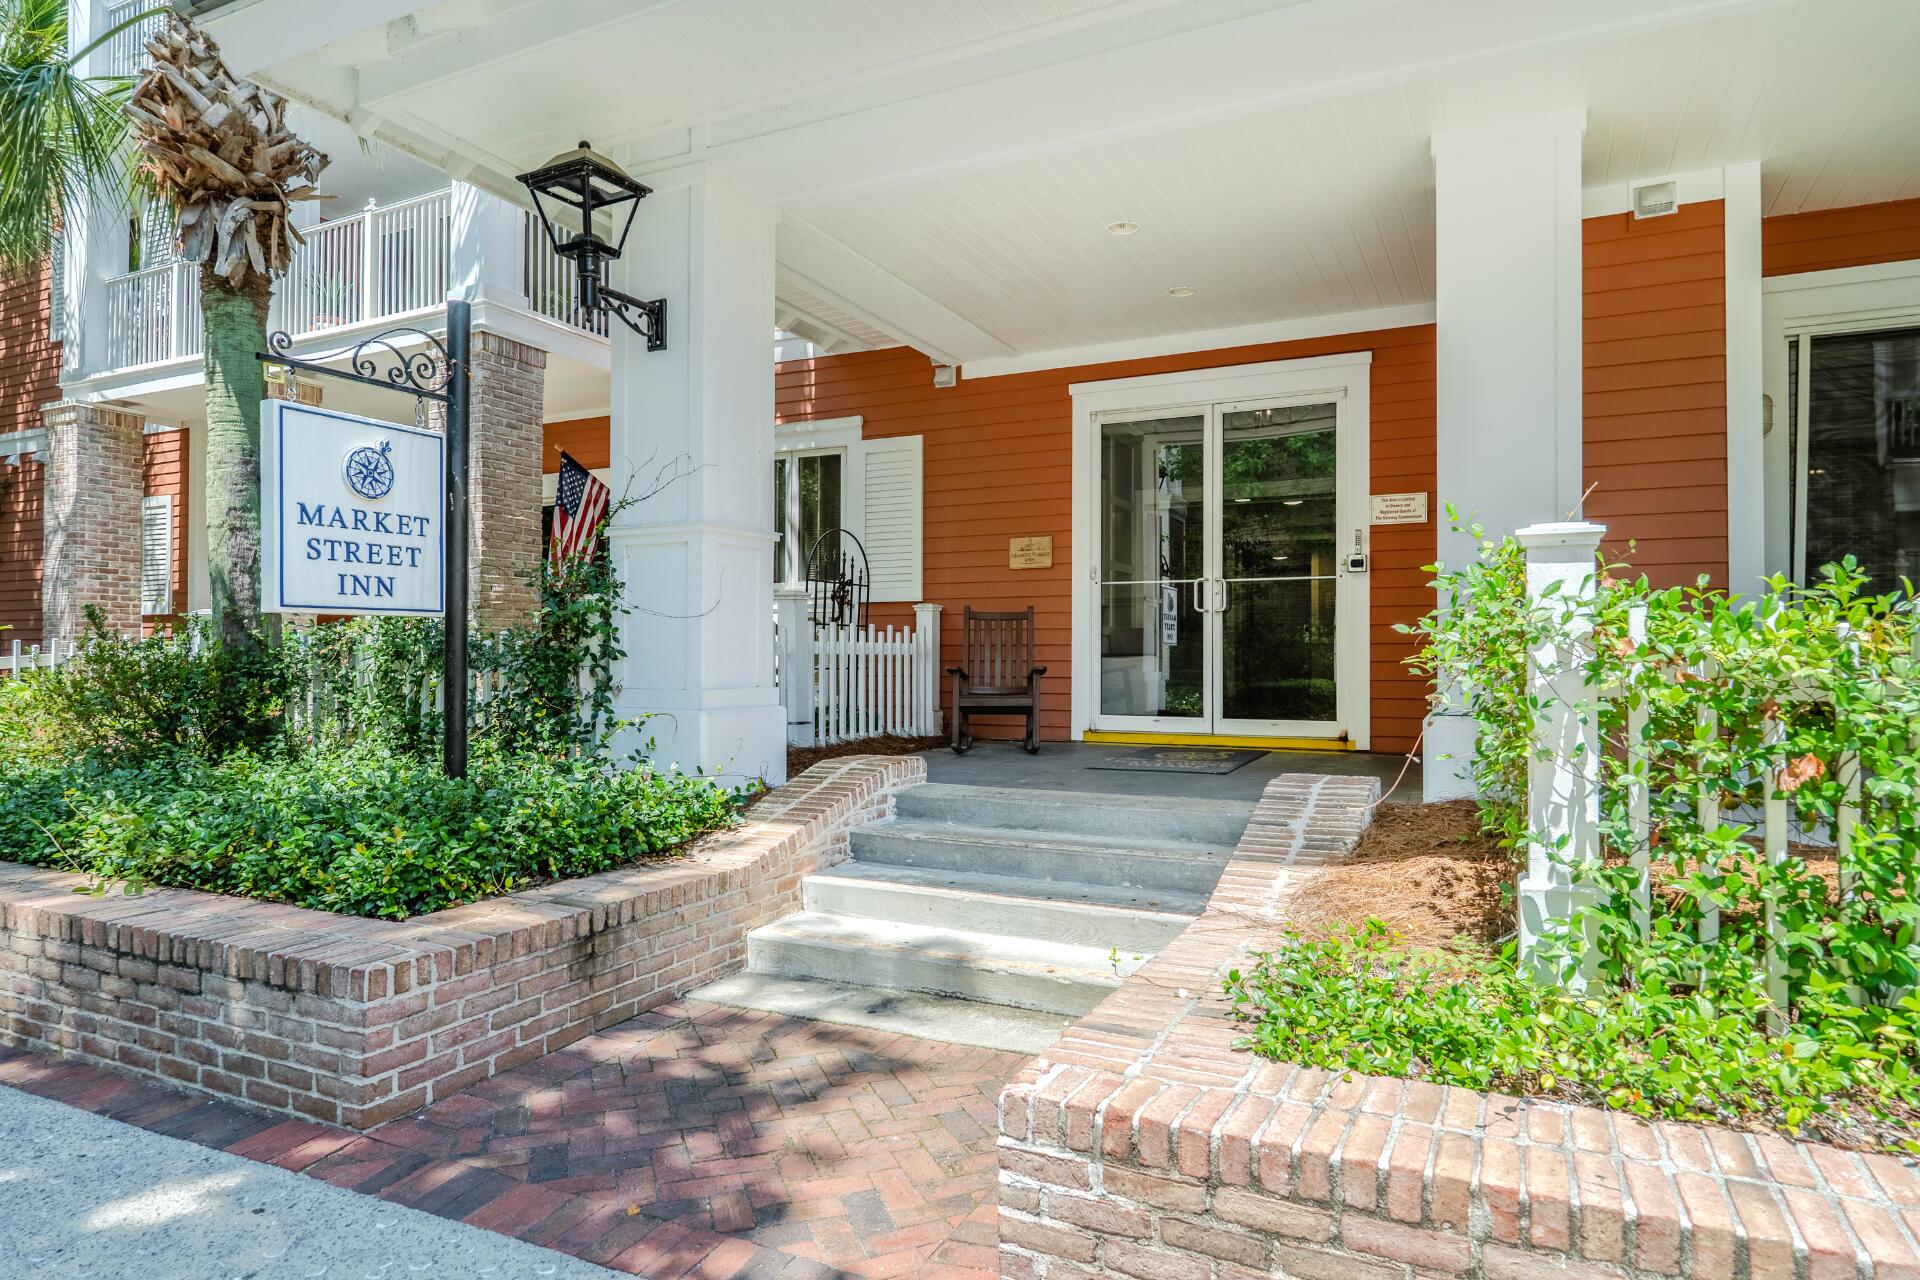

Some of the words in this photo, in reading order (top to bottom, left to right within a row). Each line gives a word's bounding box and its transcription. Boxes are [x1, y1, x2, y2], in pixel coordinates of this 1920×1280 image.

[296, 502, 430, 537] MARKET
[306, 538, 422, 567] STREET
[337, 573, 396, 597] INN
